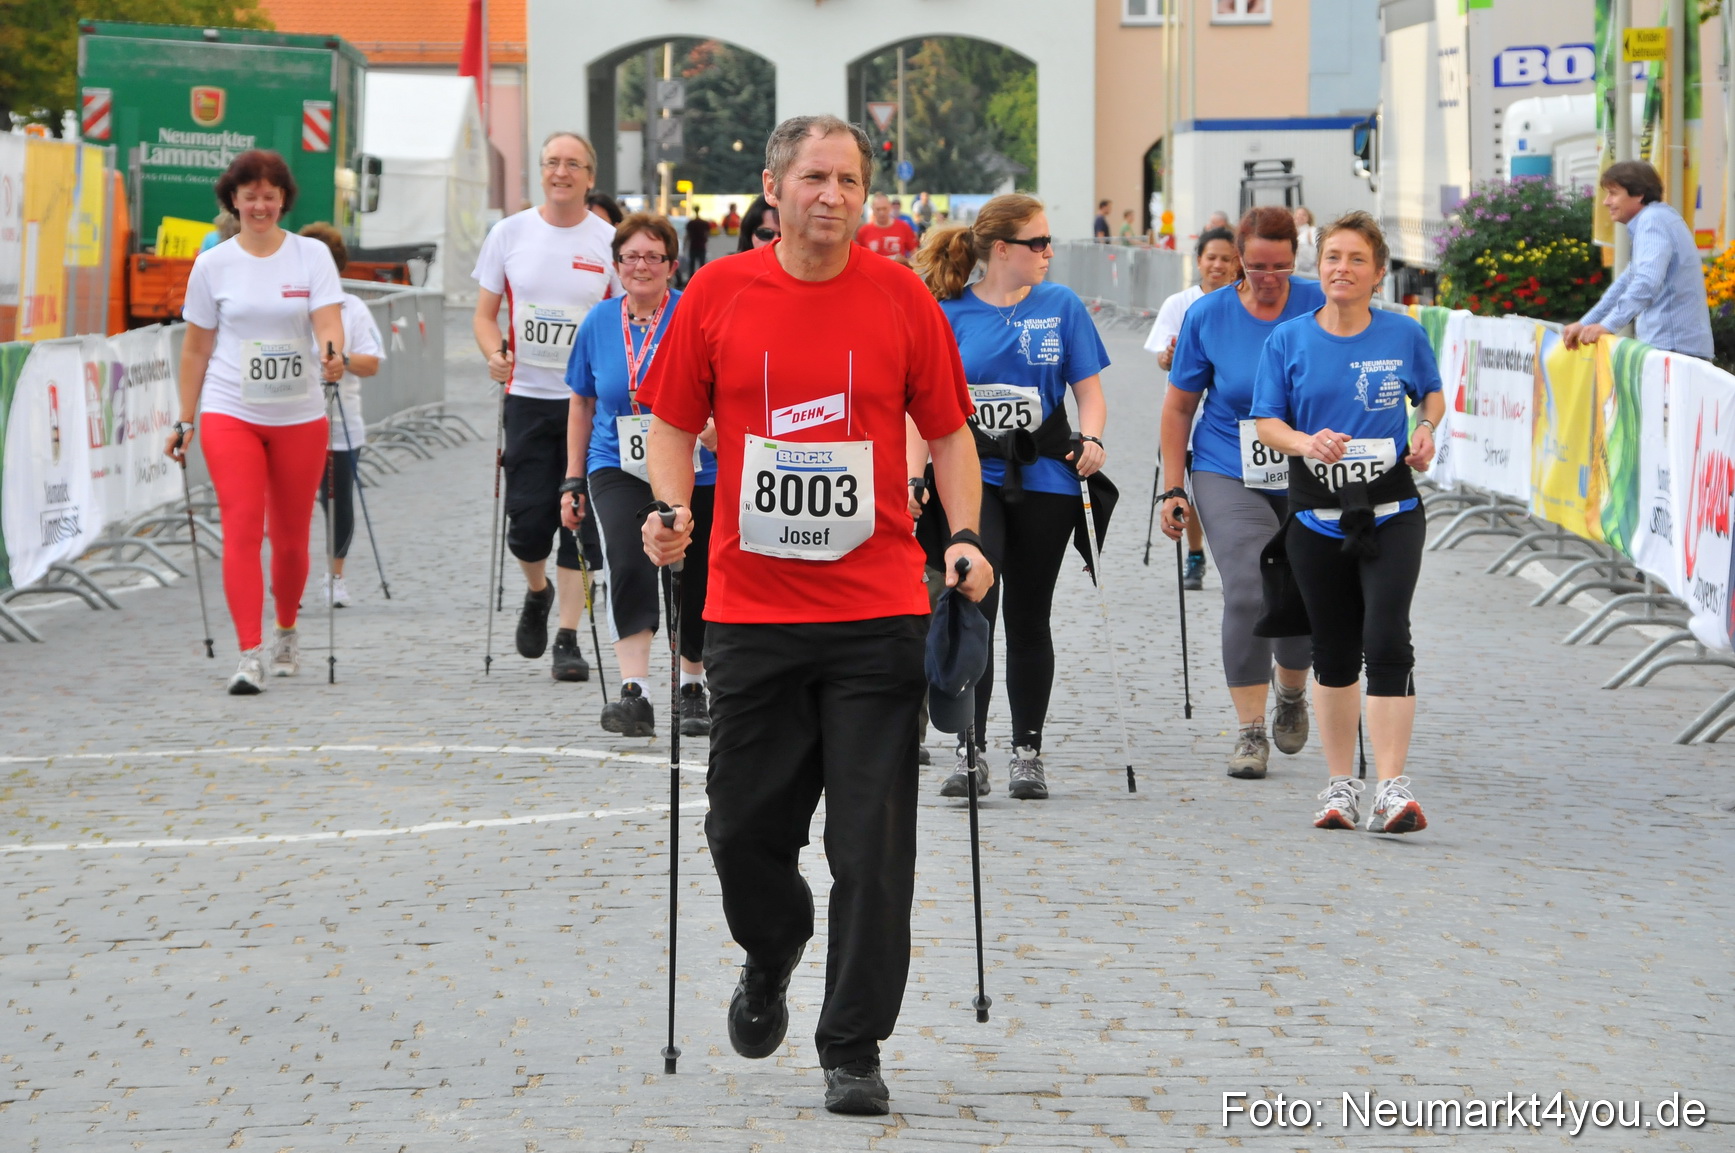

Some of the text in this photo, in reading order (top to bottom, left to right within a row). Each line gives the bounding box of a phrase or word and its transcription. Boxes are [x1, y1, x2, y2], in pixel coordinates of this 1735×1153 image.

[1637, 30, 1663, 43] Kinder-
[1493, 43, 1648, 88] BO
[158, 127, 256, 148] Neumarkter
[139, 141, 238, 169] Lammsb
[525, 319, 578, 345] 8077
[249, 355, 302, 380] 8076
[1350, 361, 1362, 369] 12.
[1361, 365, 1397, 373] STADTLAUF
[974, 389, 1011, 397] BOCK
[791, 405, 825, 424] DEHN
[630, 434, 646, 460] 8
[776, 449, 833, 464] BOCK
[1252, 439, 1289, 466] 80
[1314, 461, 1385, 491] 8035
[755, 470, 858, 517] 8003
[745, 503, 750, 511] N
[779, 526, 830, 545] Josef
